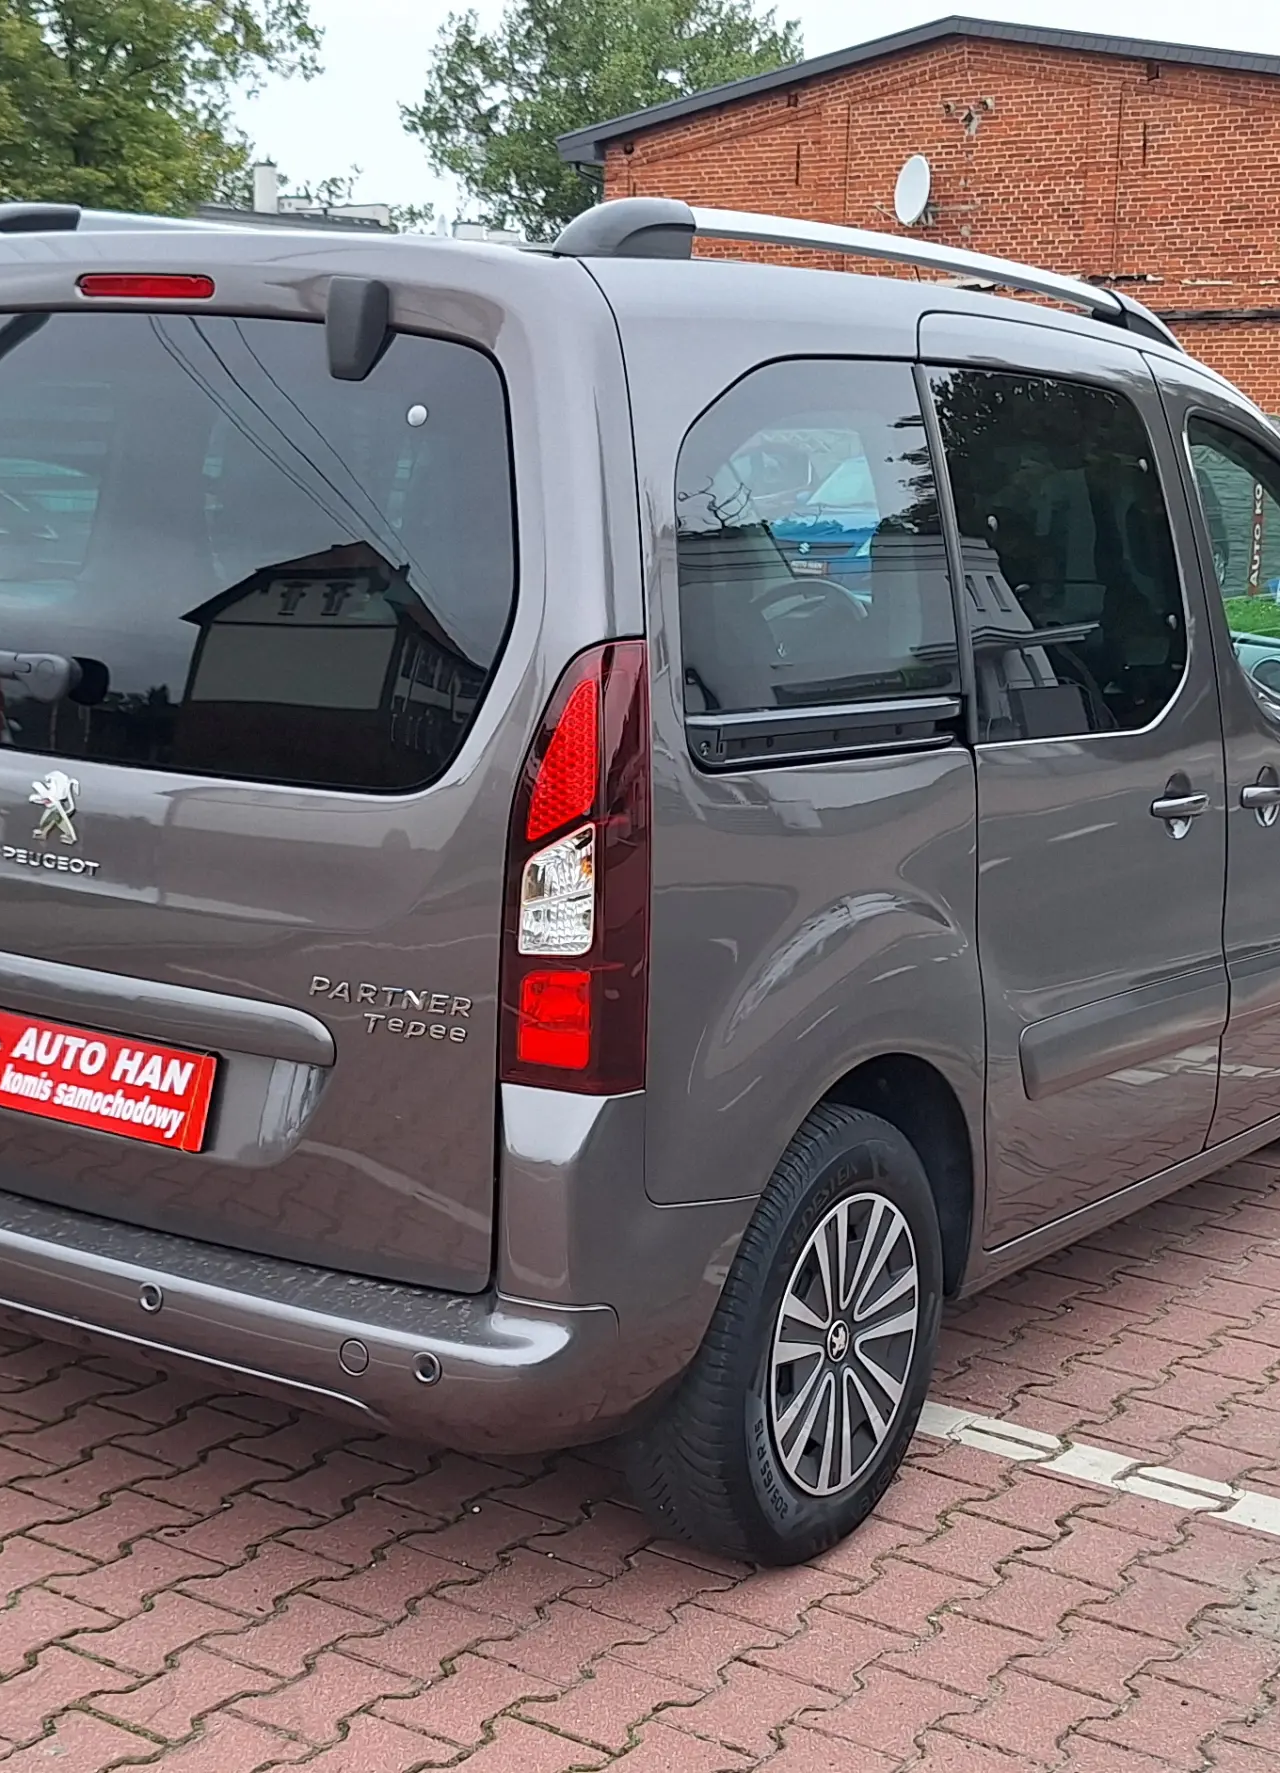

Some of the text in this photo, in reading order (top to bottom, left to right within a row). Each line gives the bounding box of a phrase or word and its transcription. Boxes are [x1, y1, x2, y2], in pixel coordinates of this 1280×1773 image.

[1249, 521, 1262, 587] AUTO
[2, 845, 100, 876] PEUGEOT
[309, 976, 472, 1018] PARTNER
[363, 1012, 467, 1043] Tepee
[10, 1027, 195, 1096] AUTO HAN
[52, 1084, 186, 1139] samochodowy
